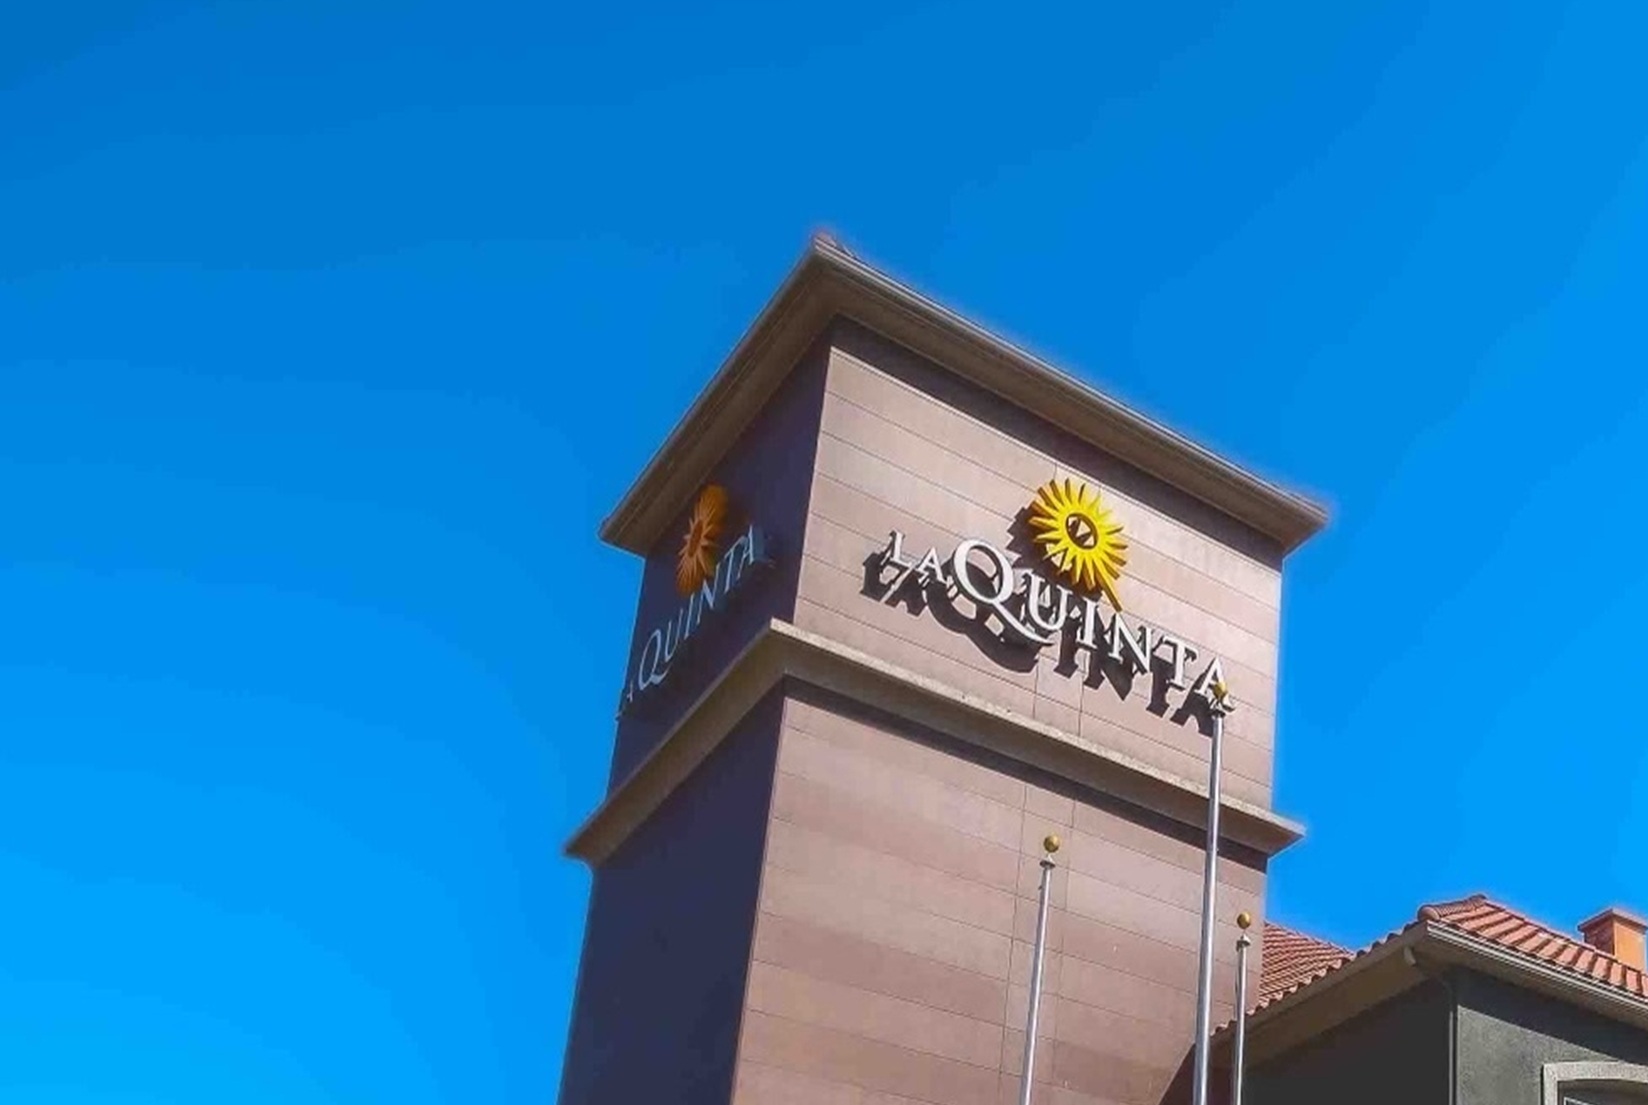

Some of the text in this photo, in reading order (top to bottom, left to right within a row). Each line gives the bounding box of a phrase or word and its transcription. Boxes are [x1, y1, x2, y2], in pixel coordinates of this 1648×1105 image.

[637, 524, 756, 691] QUINTA
[888, 530, 1236, 712] LA QUINTA
